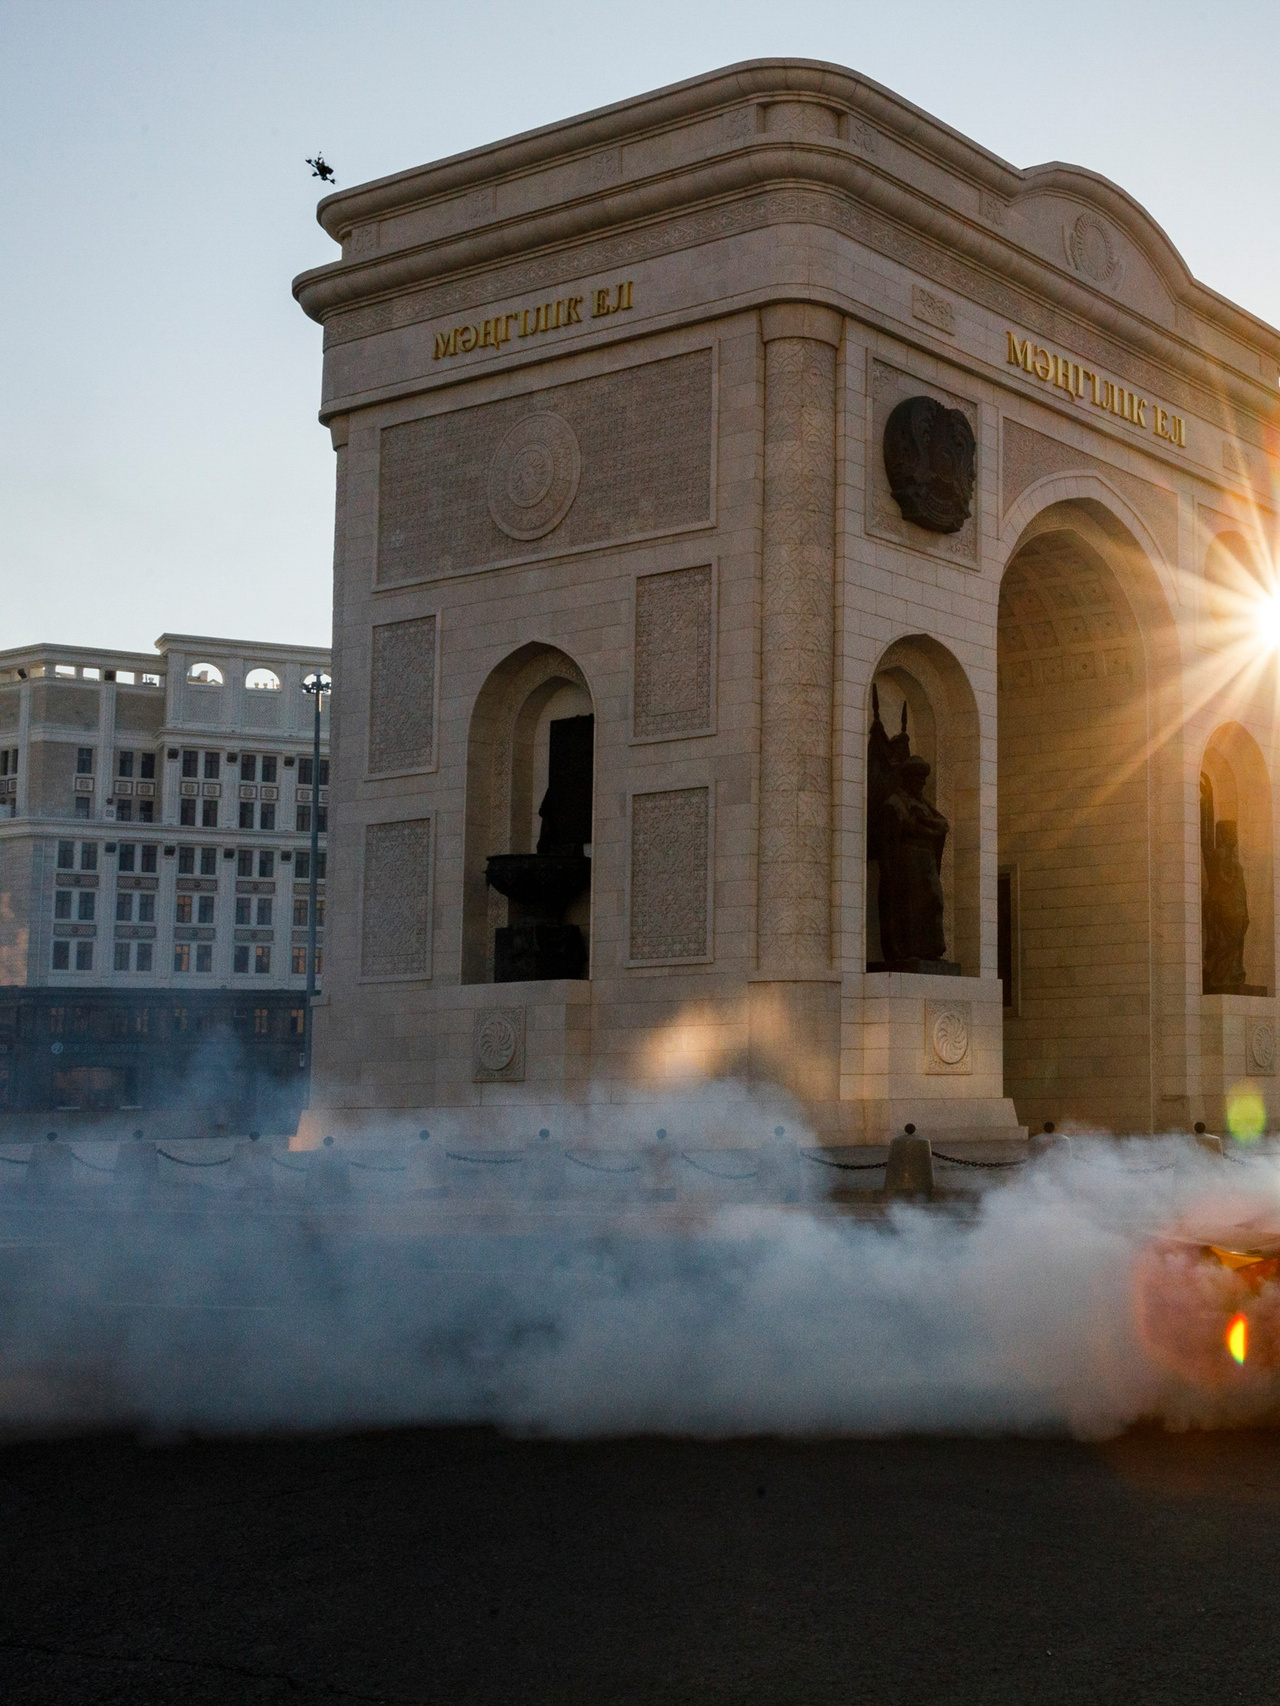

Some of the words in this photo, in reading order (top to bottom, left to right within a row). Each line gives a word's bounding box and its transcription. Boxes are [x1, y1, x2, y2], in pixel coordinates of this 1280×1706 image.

[433, 296, 583, 359] МӘҢГІЛІК
[591, 281, 633, 318] ЕЛ
[1006, 331, 1147, 429] МӘҢГІЛІК
[1152, 405, 1186, 448] ЕЛ
